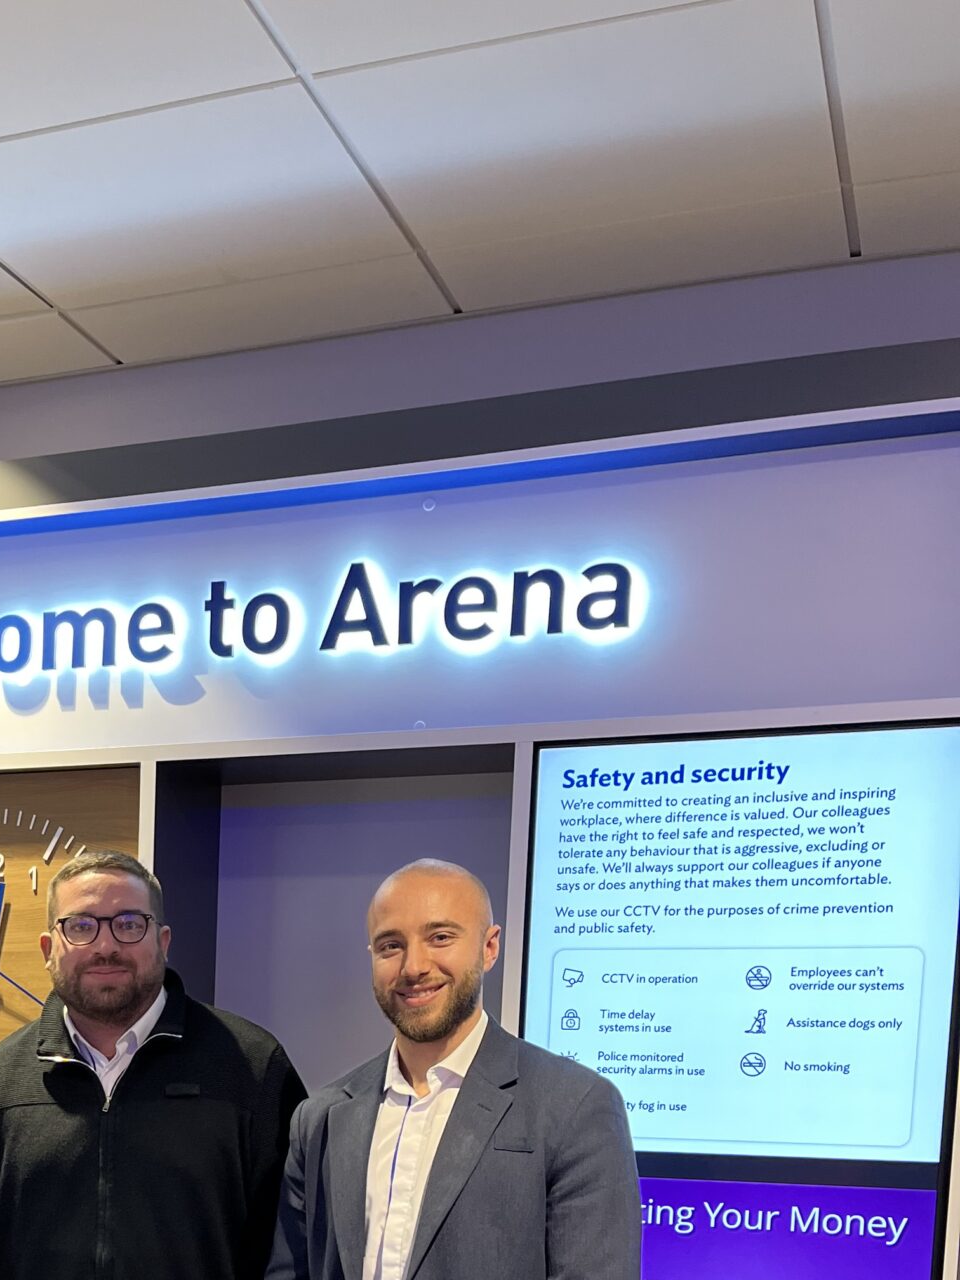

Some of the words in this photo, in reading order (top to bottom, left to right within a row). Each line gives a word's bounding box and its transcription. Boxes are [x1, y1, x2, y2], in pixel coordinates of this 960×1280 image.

[204, 581, 290, 660] to
[320, 560, 634, 652] Arena
[562, 767, 635, 791] Safety
[640, 764, 684, 785] and
[690, 761, 790, 784] security
[560, 798, 594, 810] We're
[596, 795, 662, 809] committed
[665, 797, 678, 806] to
[680, 793, 731, 807] creating
[733, 795, 749, 804] an
[752, 790, 808, 803] inclusive
[811, 787, 836, 801] and
[839, 786, 896, 802] inspiring
[559, 813, 622, 828] workplace,
[624, 812, 661, 824] where
[664, 810, 727, 823] difference
[730, 809, 740, 820] is
[743, 807, 788, 820] valued.
[792, 806, 818, 818] Our
[821, 804, 890, 819] colleagues
[28, 866, 37, 892] 1
[554, 906, 574, 917] We
[577, 908, 597, 917] use
[600, 908, 620, 917] our
[623, 904, 660, 916] CCTV
[663, 904, 681, 916] for
[683, 904, 704, 916] the
[706, 906, 763, 918] purposes
[766, 902, 780, 915] of
[782, 903, 819, 914] crime
[822, 901, 893, 916] prevention
[553, 922, 575, 933] and
[578, 921, 614, 936] public
[616, 921, 655, 935] safety.
[601, 972, 634, 983] CCTV
[635, 973, 645, 983] in
[647, 973, 698, 985] operation
[790, 966, 852, 979] Employees
[854, 965, 884, 977] can't
[788, 979, 834, 990] override
[836, 982, 856, 990] our
[858, 981, 904, 992] systems
[599, 1008, 626, 1019] Time
[627, 1009, 655, 1021] delay
[598, 1023, 639, 1034] systems
[641, 1022, 651, 1032] in
[785, 1017, 846, 1028] Assistance
[848, 1017, 875, 1030] dogs
[877, 1017, 902, 1031] only
[597, 1050, 628, 1061] Police
[629, 1051, 684, 1062] monitored
[596, 1065, 636, 1076] security
[638, 1064, 672, 1075] alarms
[674, 1065, 684, 1075] in
[686, 1068, 705, 1076] use
[784, 1060, 801, 1071] No
[803, 1061, 850, 1074] smoking
[637, 1098, 655, 1112] fog
[656, 1100, 666, 1110] in
[668, 1103, 687, 1111] use
[703, 1201, 780, 1230] Your
[789, 1205, 908, 1245] Money
